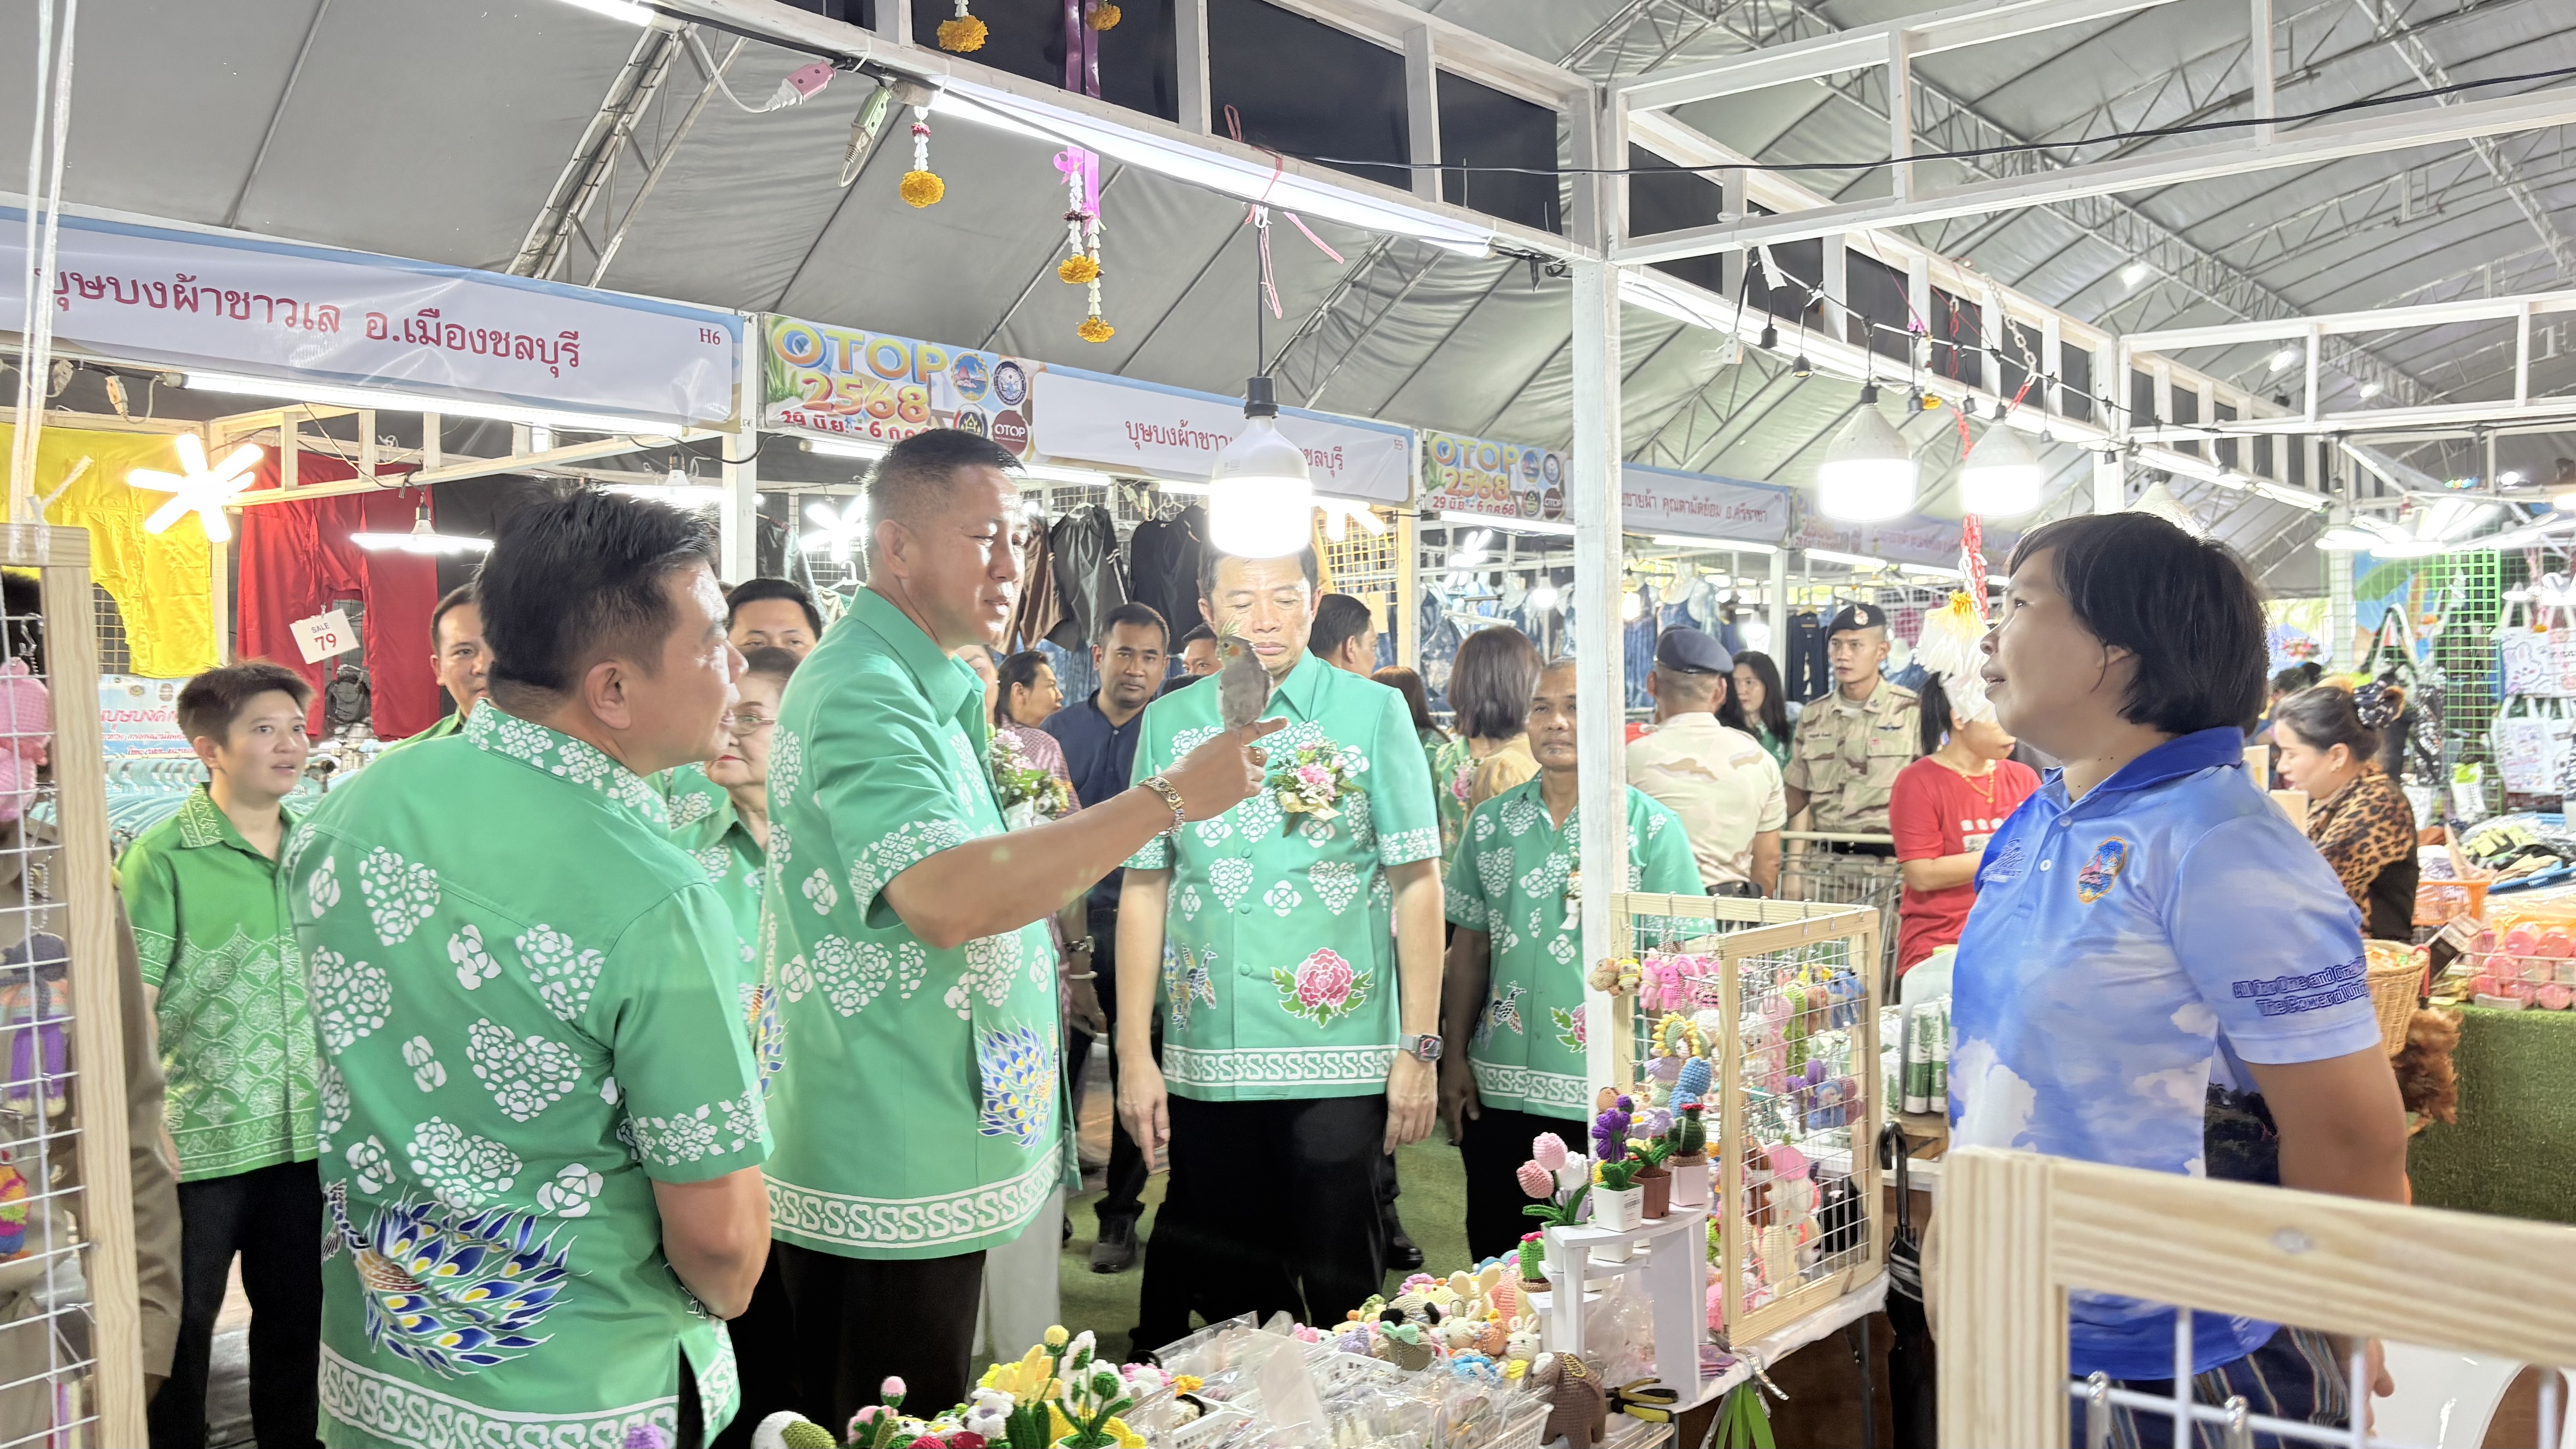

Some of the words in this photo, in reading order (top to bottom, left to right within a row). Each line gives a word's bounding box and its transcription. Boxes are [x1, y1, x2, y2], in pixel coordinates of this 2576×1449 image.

[365, 307, 580, 378] อ.เมืองชลบุรี
[699, 328, 721, 345] H6
[773, 322, 948, 384] OTOP
[801, 372, 930, 423] 2568
[869, 421, 882, 438] 6
[995, 424, 1025, 437] OTOP
[1125, 419, 1233, 451] บุษบงผ้าชาว
[1431, 436, 1520, 473] OTOP
[1444, 469, 1511, 501] 2568
[1433, 496, 1446, 508] 29
[1477, 501, 1484, 513] 6
[311, 623, 331, 633] SALE
[314, 633, 336, 651] 79
